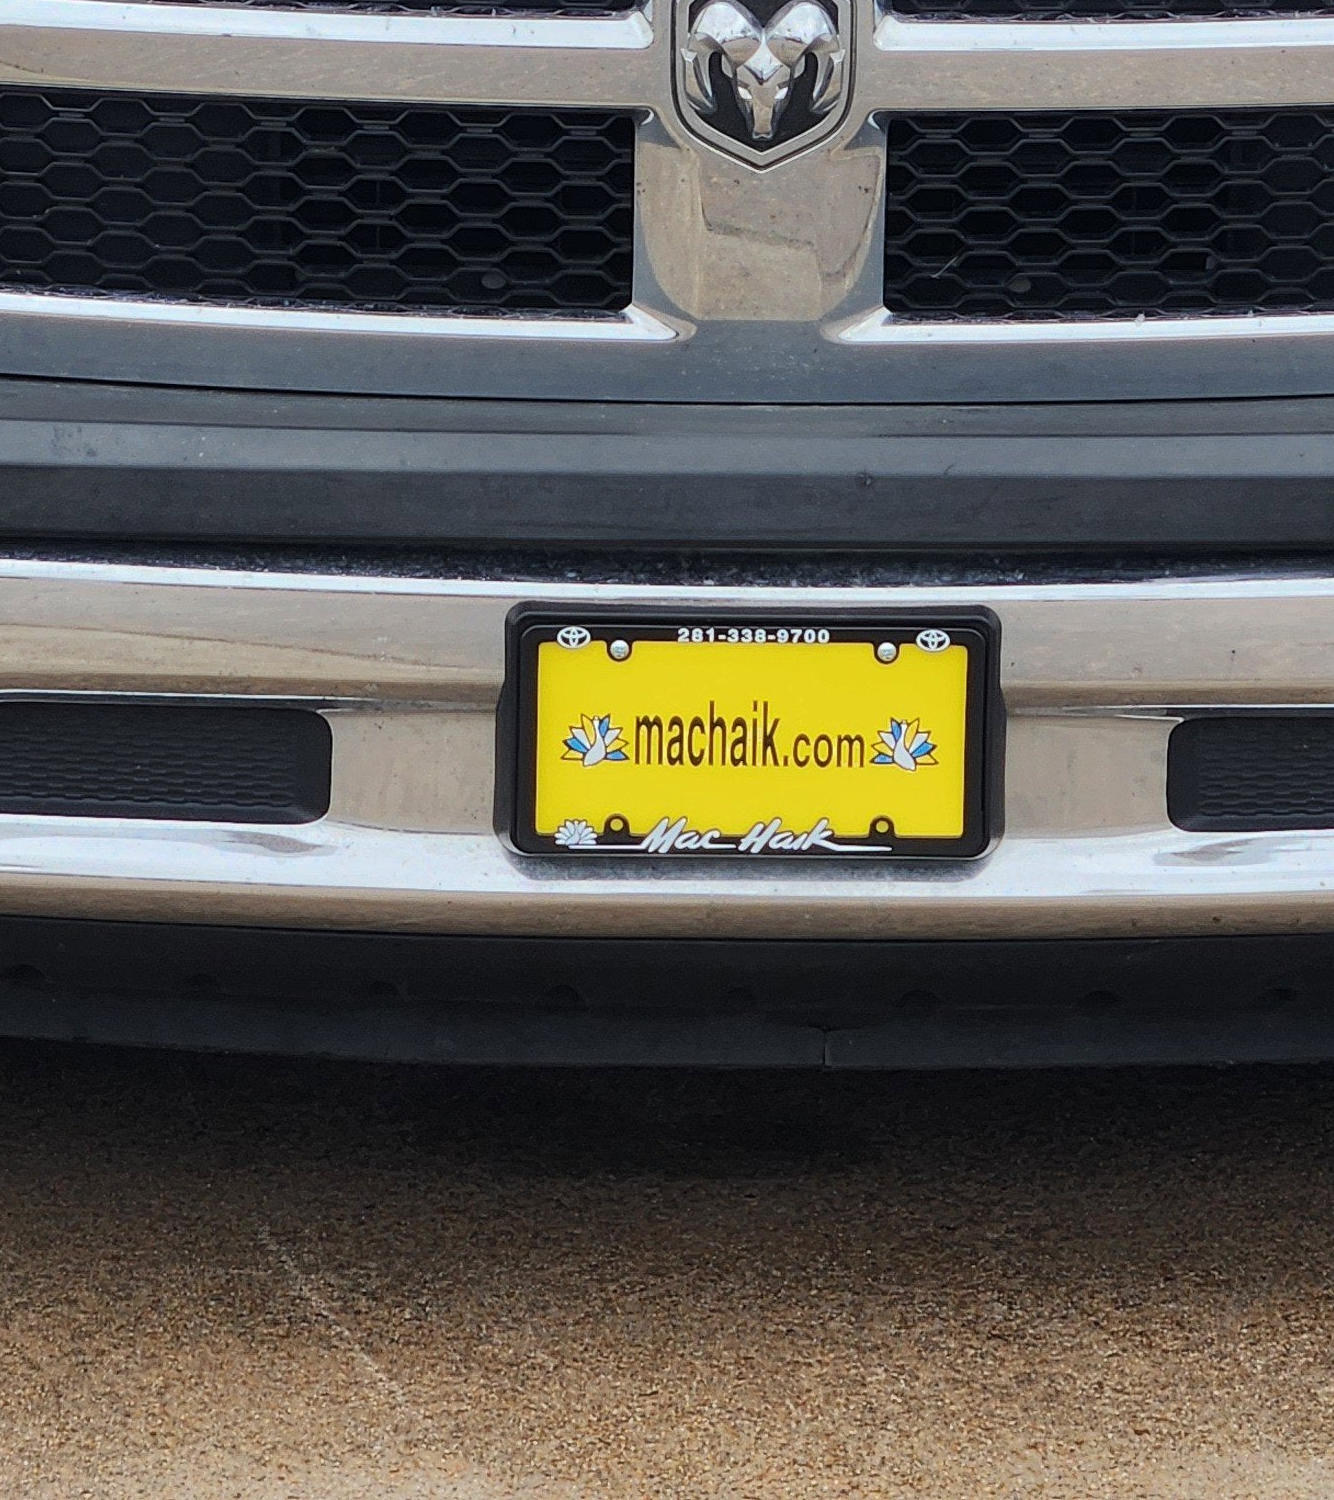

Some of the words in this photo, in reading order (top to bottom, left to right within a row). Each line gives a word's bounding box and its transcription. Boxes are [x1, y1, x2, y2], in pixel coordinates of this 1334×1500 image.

[677, 627, 830, 644] 281-338-9700
[634, 699, 866, 768] machaik.com
[639, 816, 735, 854] Mac
[738, 816, 847, 854] Haik
